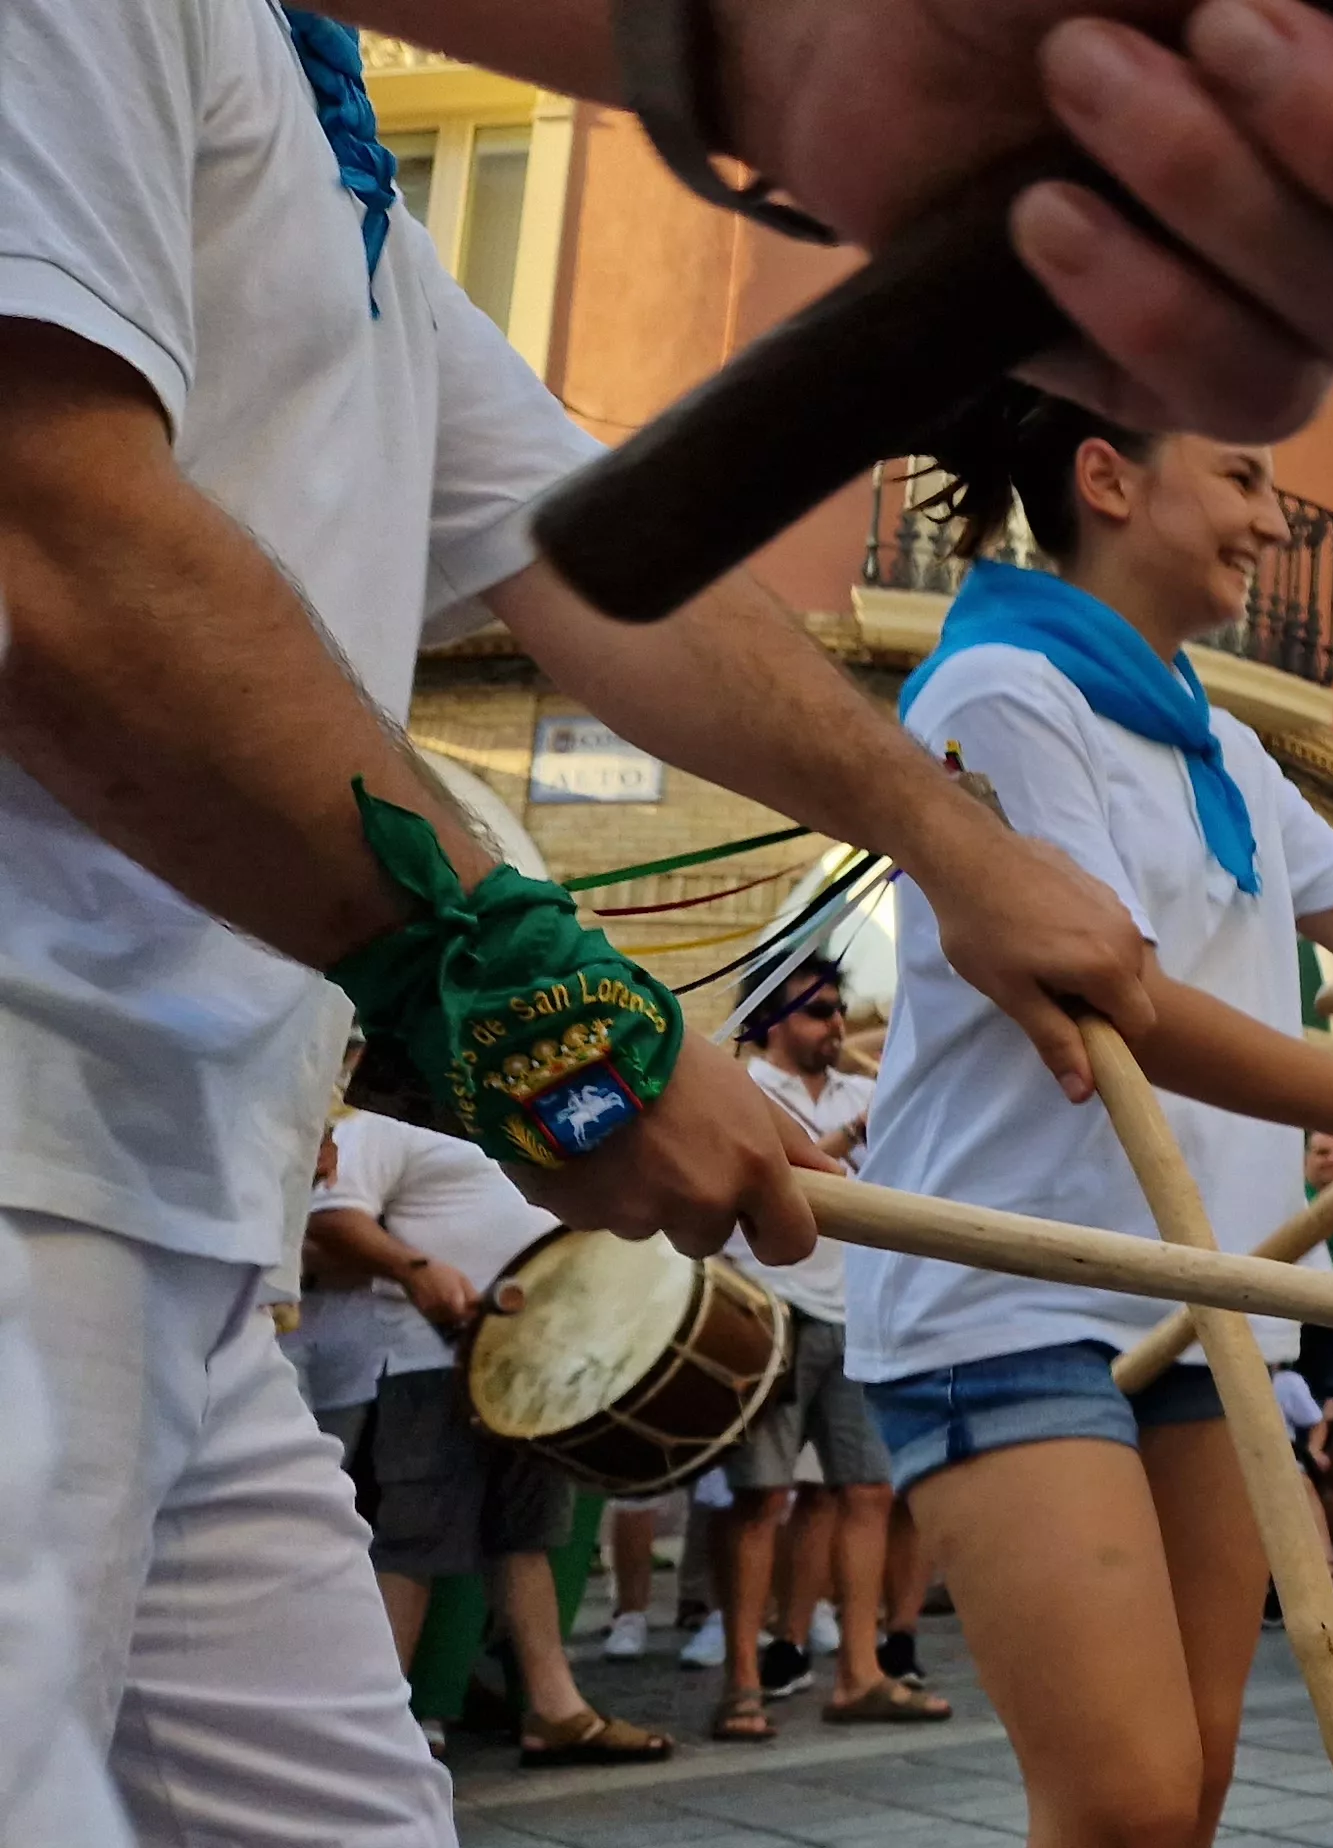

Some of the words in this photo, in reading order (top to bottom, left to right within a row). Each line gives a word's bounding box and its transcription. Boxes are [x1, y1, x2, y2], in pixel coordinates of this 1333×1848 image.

[551, 767, 643, 789] ALTO
[468, 1019, 507, 1047] de
[510, 983, 571, 1020] San
[576, 968, 667, 1034] Lorenzo
